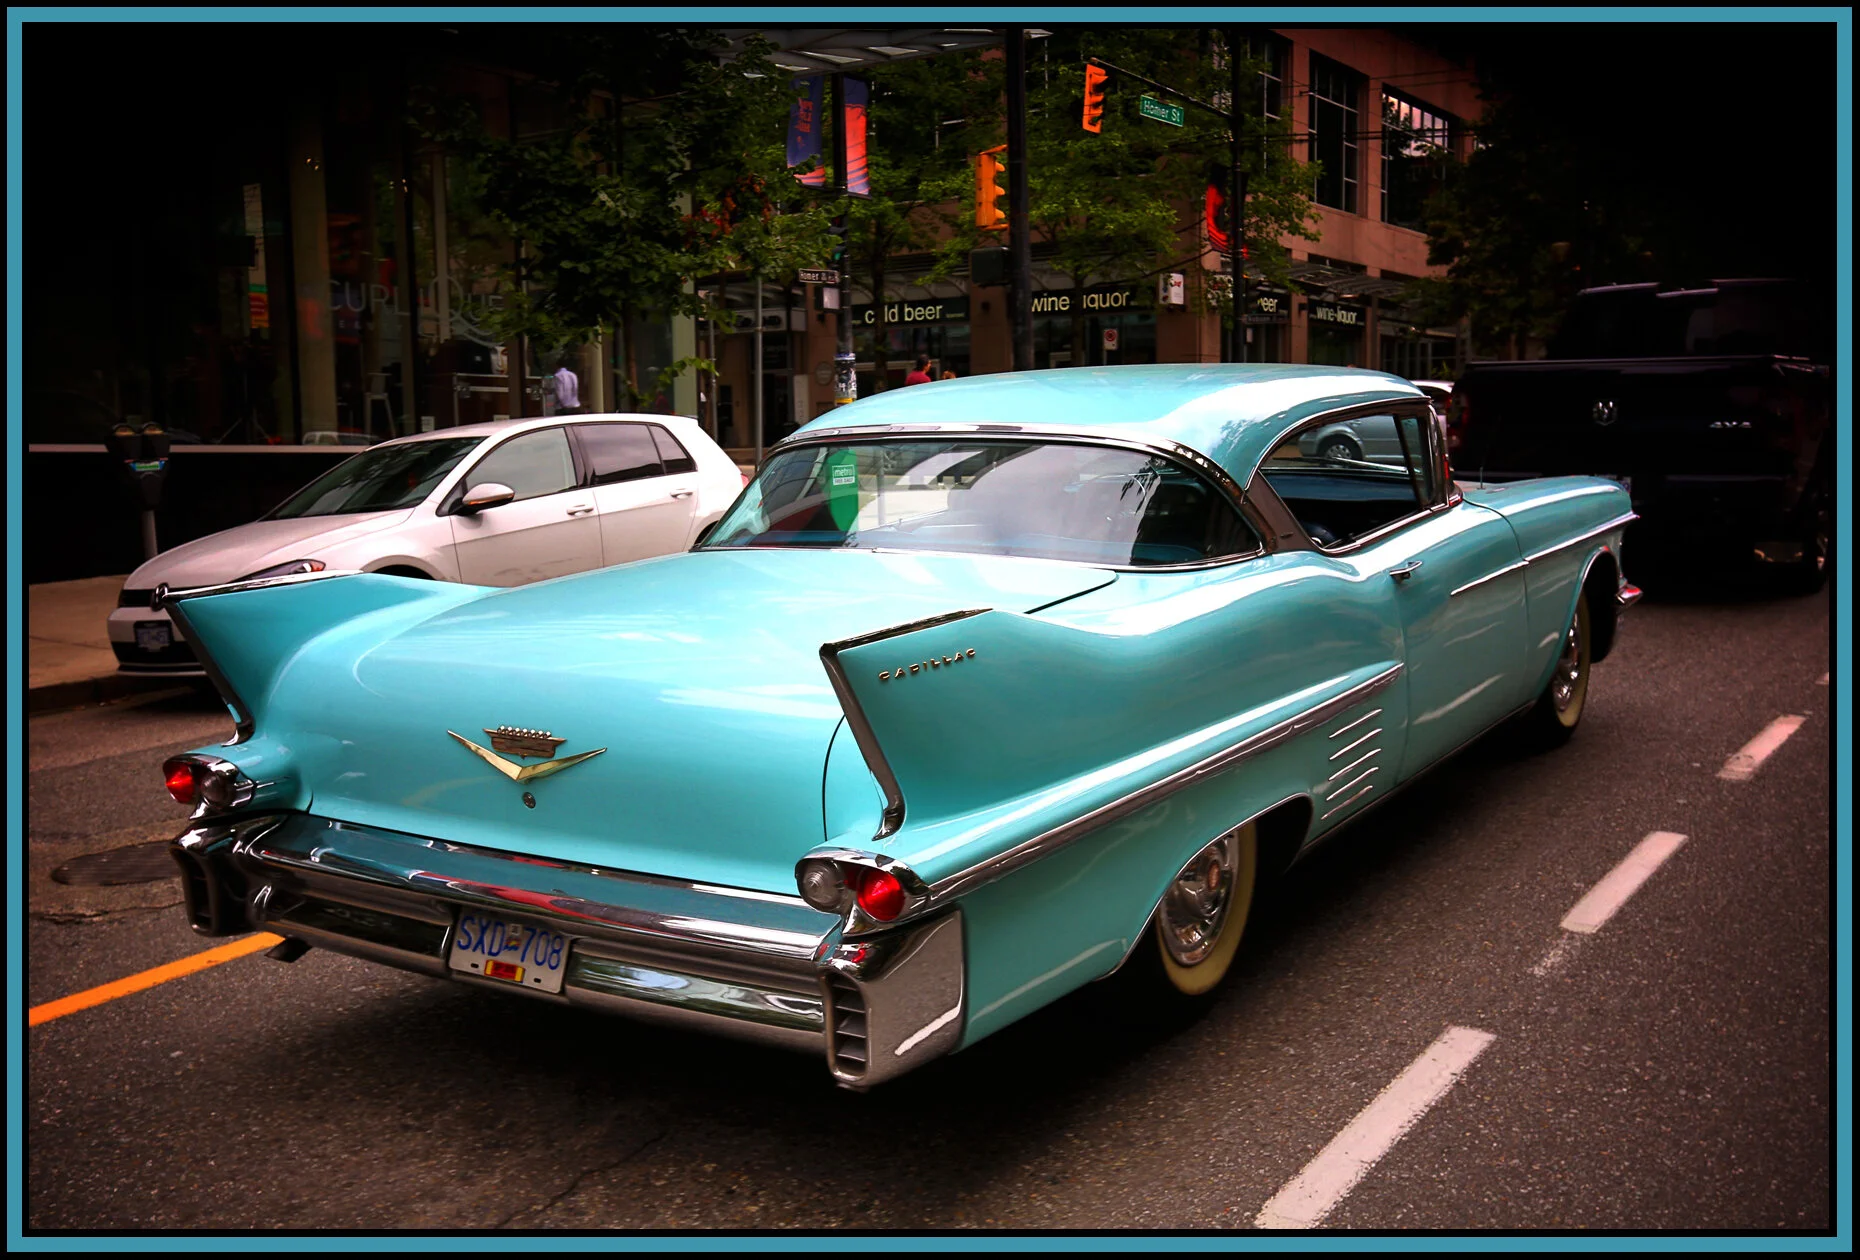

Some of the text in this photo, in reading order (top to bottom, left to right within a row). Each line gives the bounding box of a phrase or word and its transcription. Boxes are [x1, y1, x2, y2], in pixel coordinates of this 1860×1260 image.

[1143, 100, 1180, 122] Homer St
[1031, 291, 1130, 312] wine iquor
[864, 303, 944, 325] cld beer
[878, 647, 977, 681] CADILLAC
